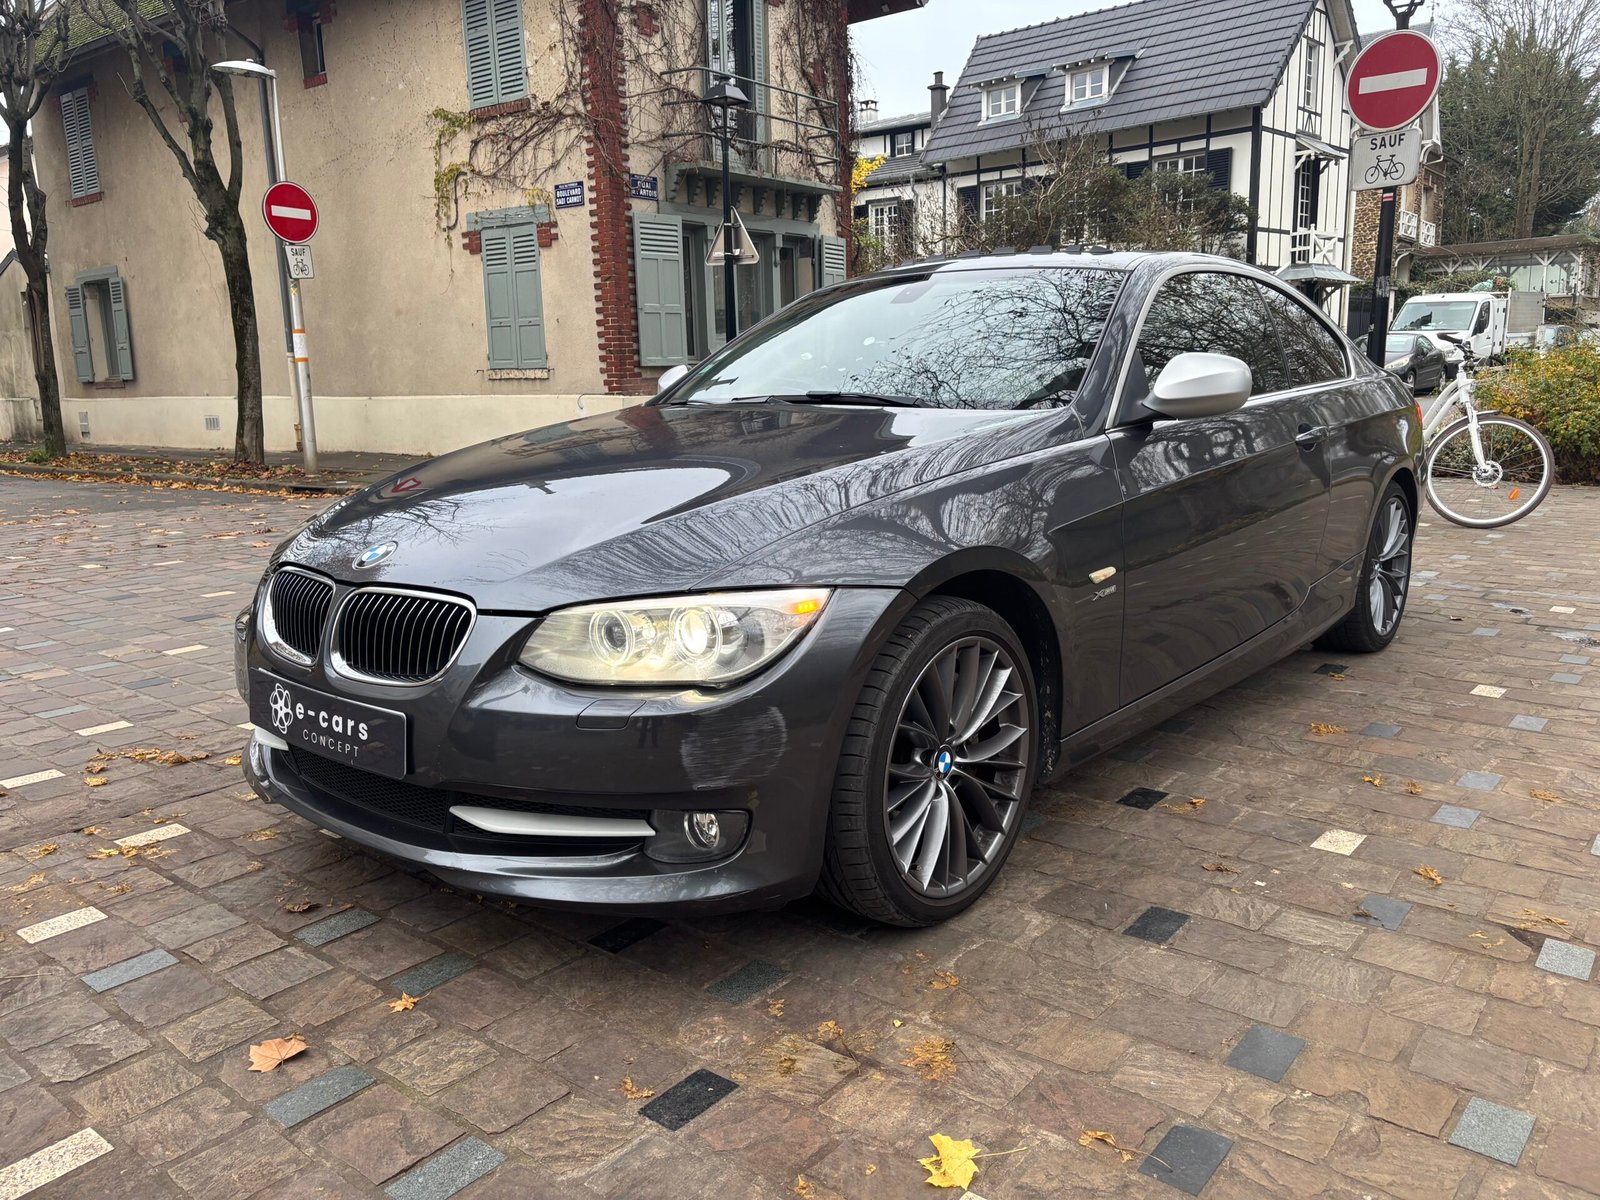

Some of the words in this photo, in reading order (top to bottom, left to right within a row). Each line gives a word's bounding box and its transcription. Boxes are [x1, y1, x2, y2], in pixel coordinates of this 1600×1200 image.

[1370, 133, 1406, 150] SAUF
[556, 187, 581, 198] BOULEVARD
[566, 195, 582, 204] CARNOT
[290, 248, 305, 256] SAUF
[295, 702, 368, 741] e-cars
[302, 729, 359, 757] CONCEPT
